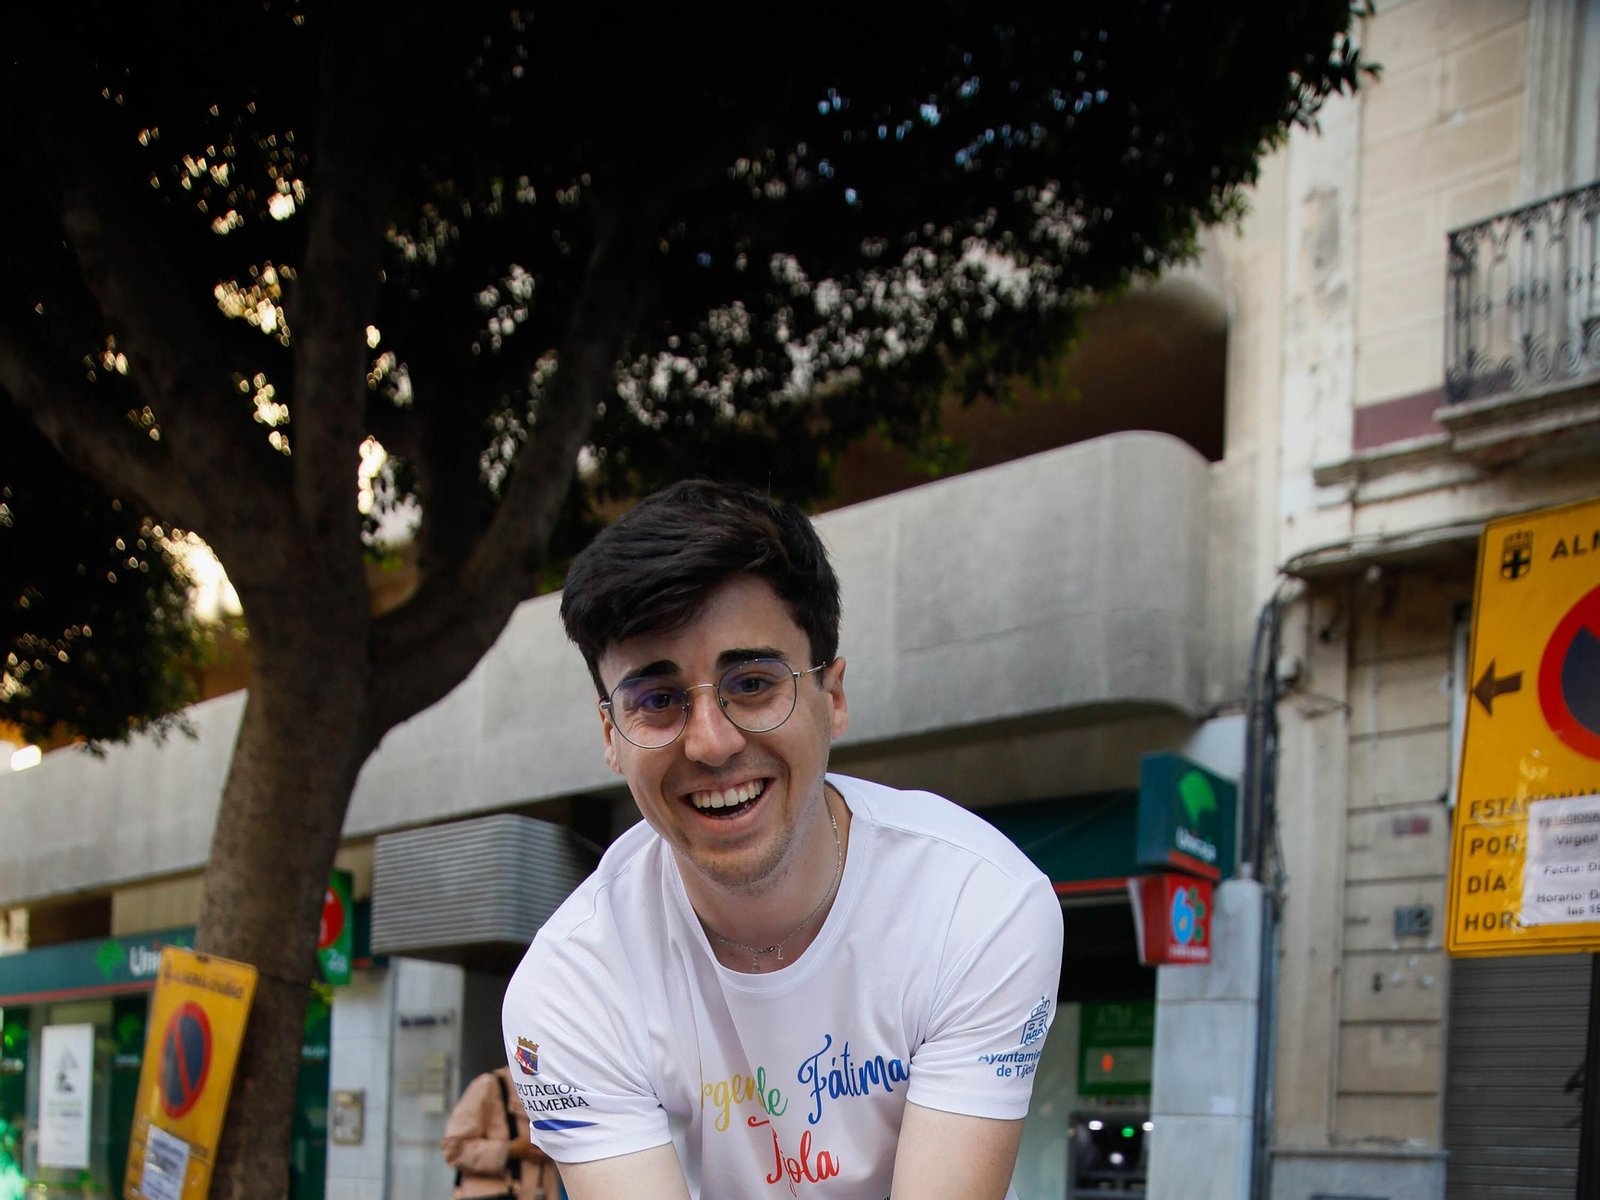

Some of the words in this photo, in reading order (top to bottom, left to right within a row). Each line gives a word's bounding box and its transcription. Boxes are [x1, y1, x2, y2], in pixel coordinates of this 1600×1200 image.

[797, 1034, 910, 1124] Fátima
[996, 1064, 1012, 1077] de
[528, 1095, 590, 1112] ALMERÍA
